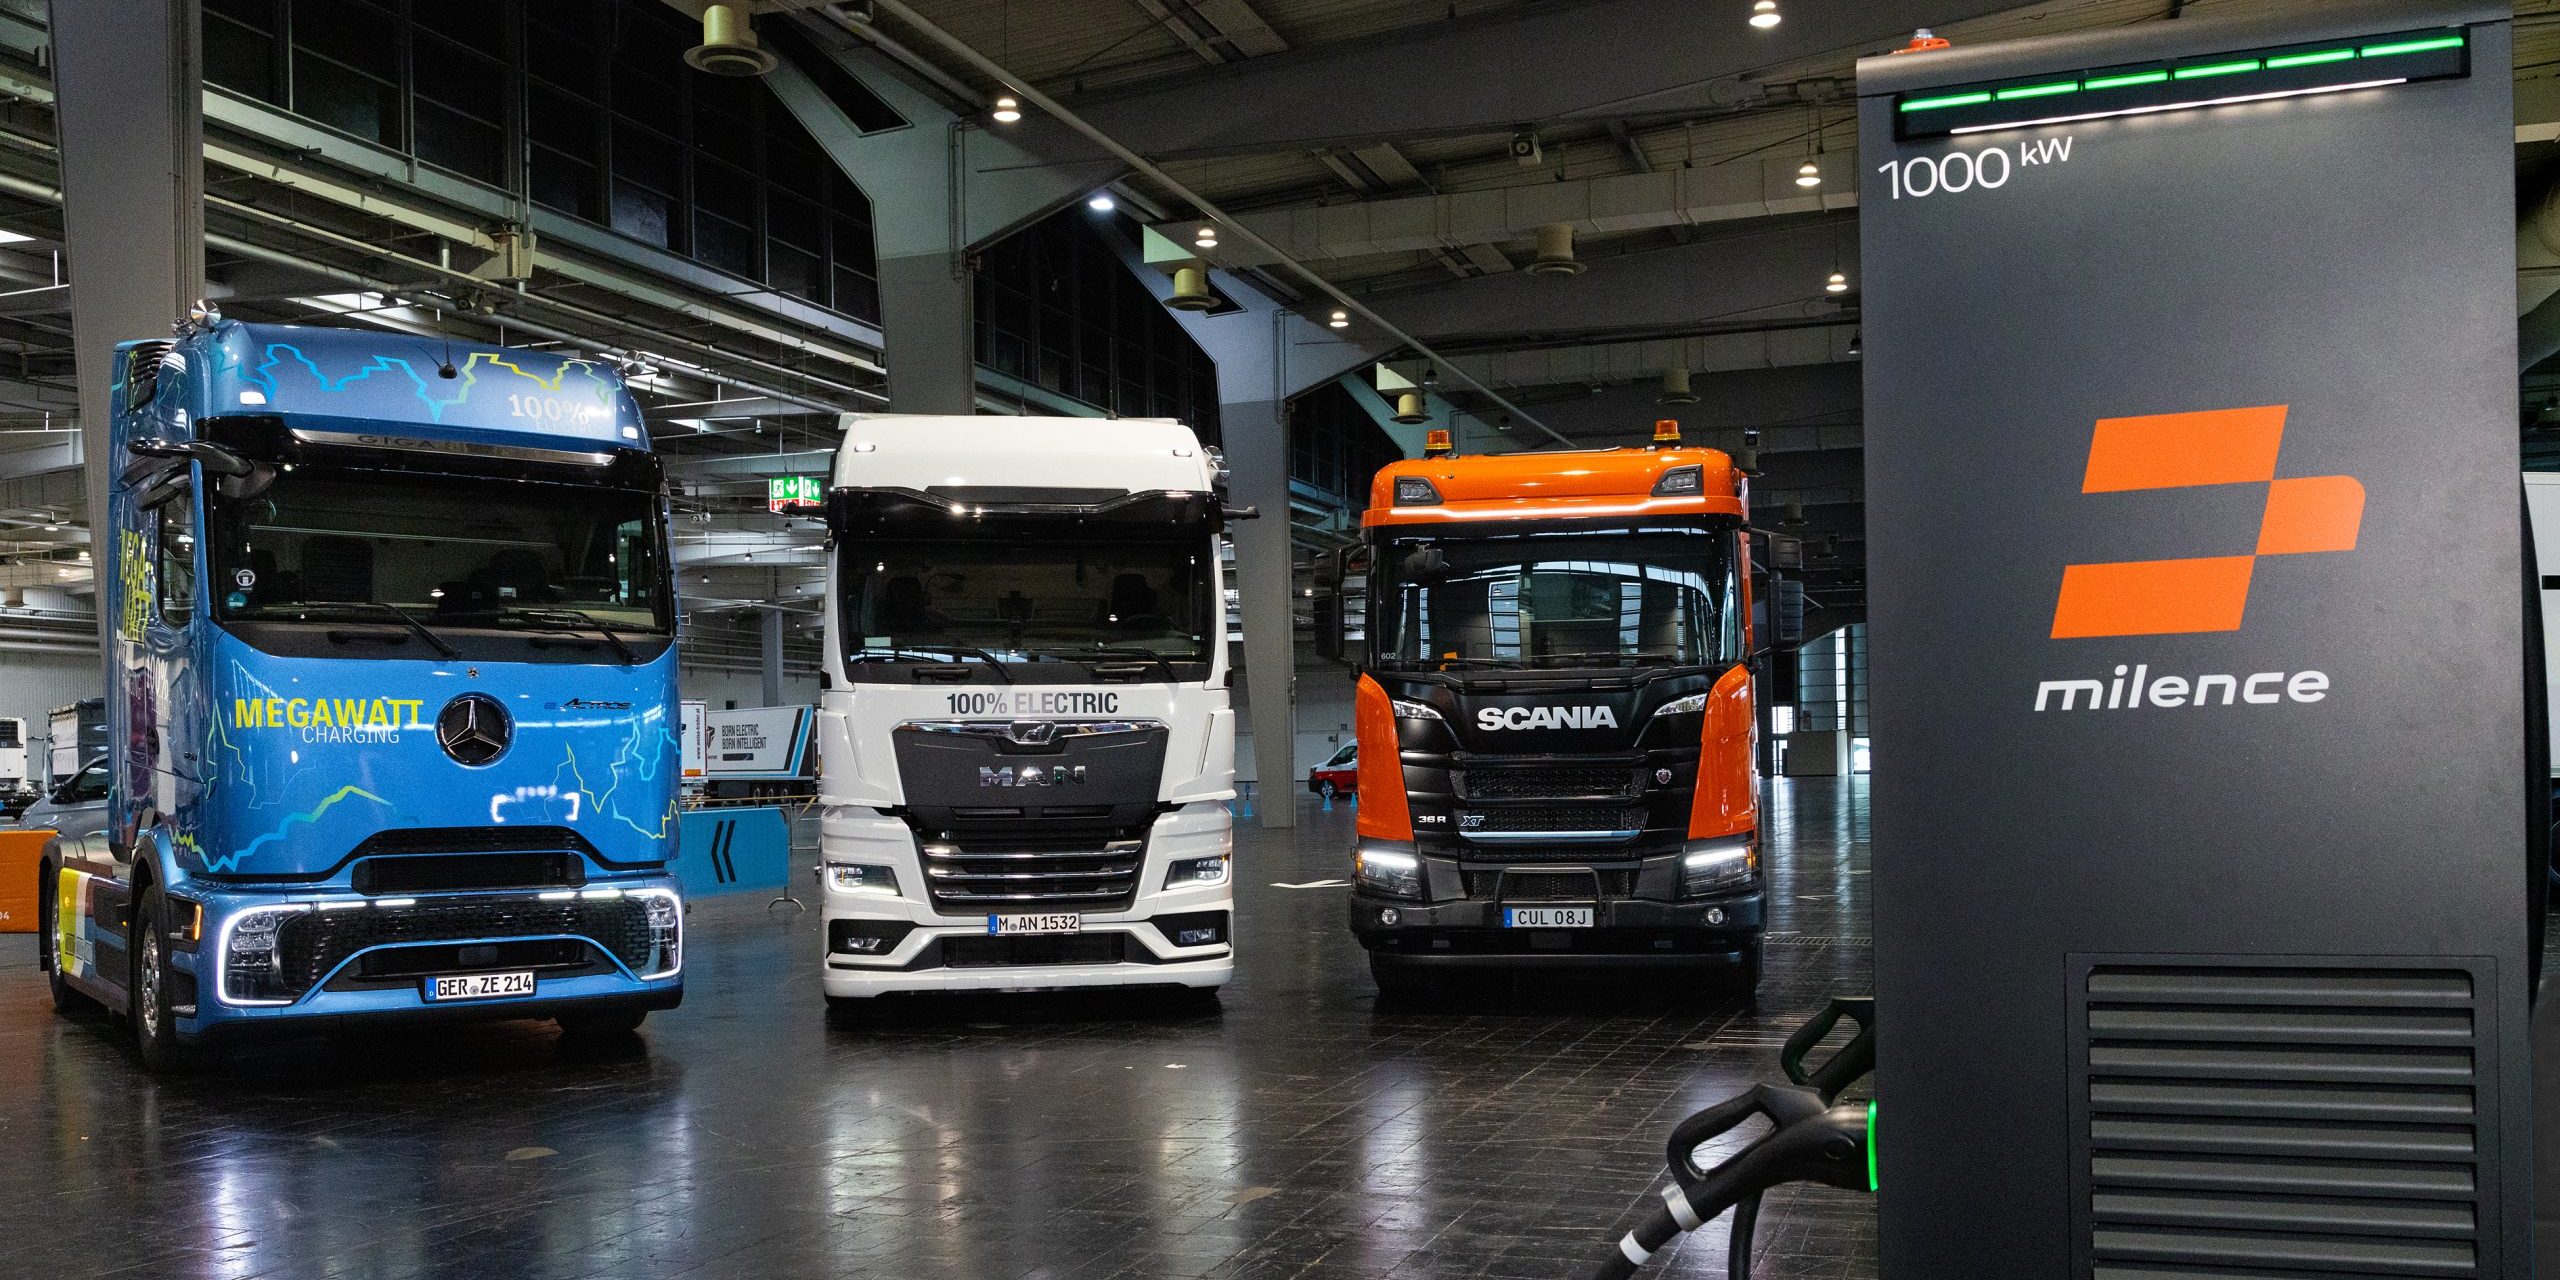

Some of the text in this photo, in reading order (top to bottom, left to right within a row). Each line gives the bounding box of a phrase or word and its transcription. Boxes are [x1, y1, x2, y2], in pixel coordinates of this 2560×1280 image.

[1878, 136, 2073, 200] 1000 kW
[508, 393, 590, 424] 100%
[2034, 664, 2329, 711] milence
[235, 697, 424, 728] MEGAWATT
[947, 692, 1118, 714] 100% ELECTRIC
[1477, 705, 1619, 731] SCANIA
[302, 725, 400, 744] CHARGING
[722, 723, 759, 736] BORN ELECTRIC
[722, 736, 767, 750] BORN INTELLIGENT
[979, 765, 1086, 787] MAN
[1460, 815, 1485, 827] XT
[998, 917, 1008, 931] M
[1018, 916, 1038, 931] AN
[1040, 915, 1078, 930] 1532
[1518, 910, 1586, 925] CUL 08J
[437, 978, 468, 997] GER
[480, 976, 500, 994] ZE
[504, 974, 532, 992] 214
